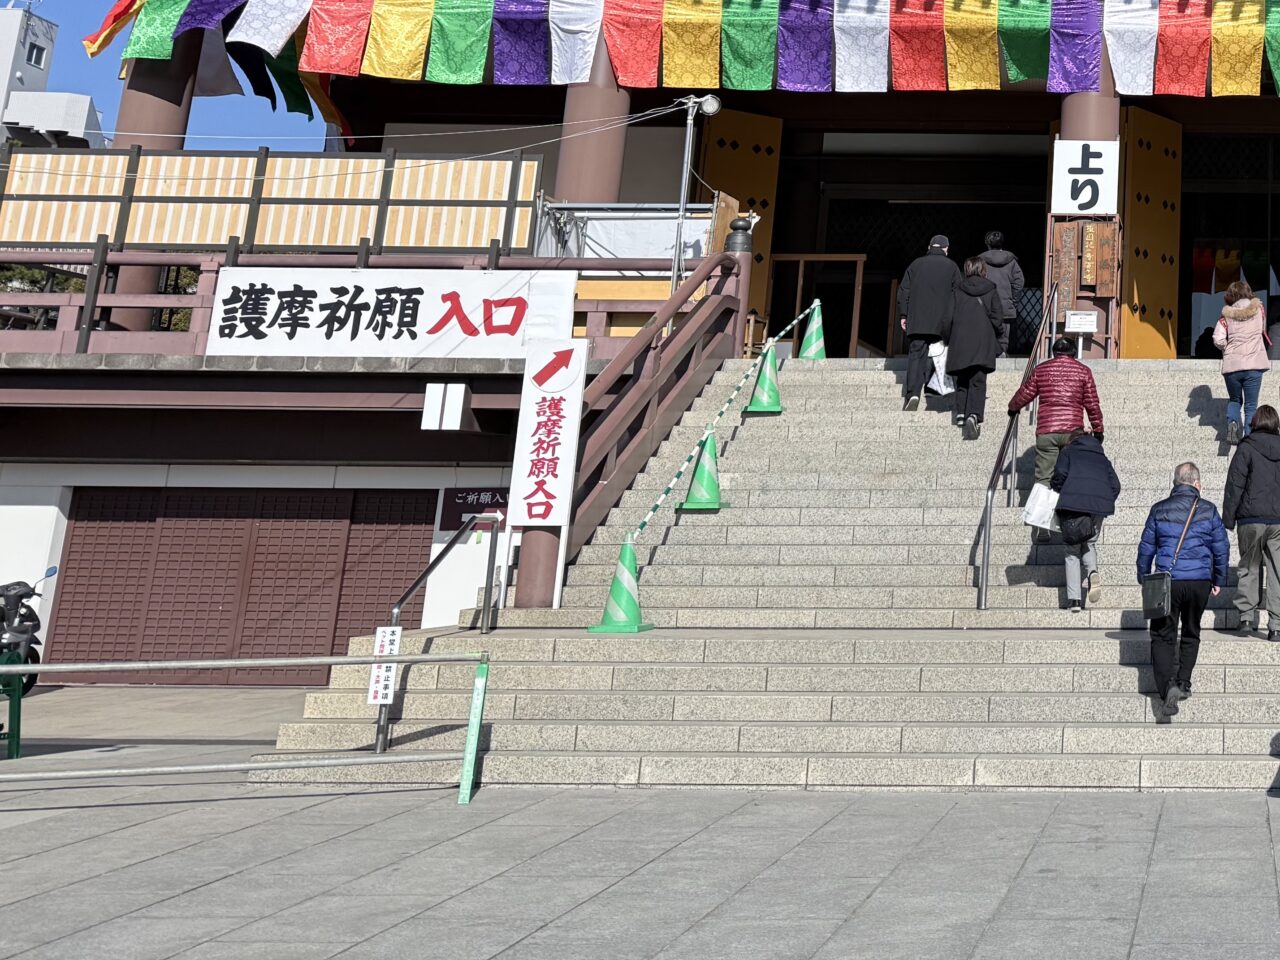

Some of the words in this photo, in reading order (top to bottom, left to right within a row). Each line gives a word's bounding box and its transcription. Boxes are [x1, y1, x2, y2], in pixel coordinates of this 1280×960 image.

[1067, 143, 1104, 211] 上り
[218, 282, 529, 341] 護摩祈願入口
[523, 395, 567, 520] 護摩祈願入口
[455, 491, 509, 505] ご祈願入
[381, 629, 397, 700] 本堂上禁止事項
